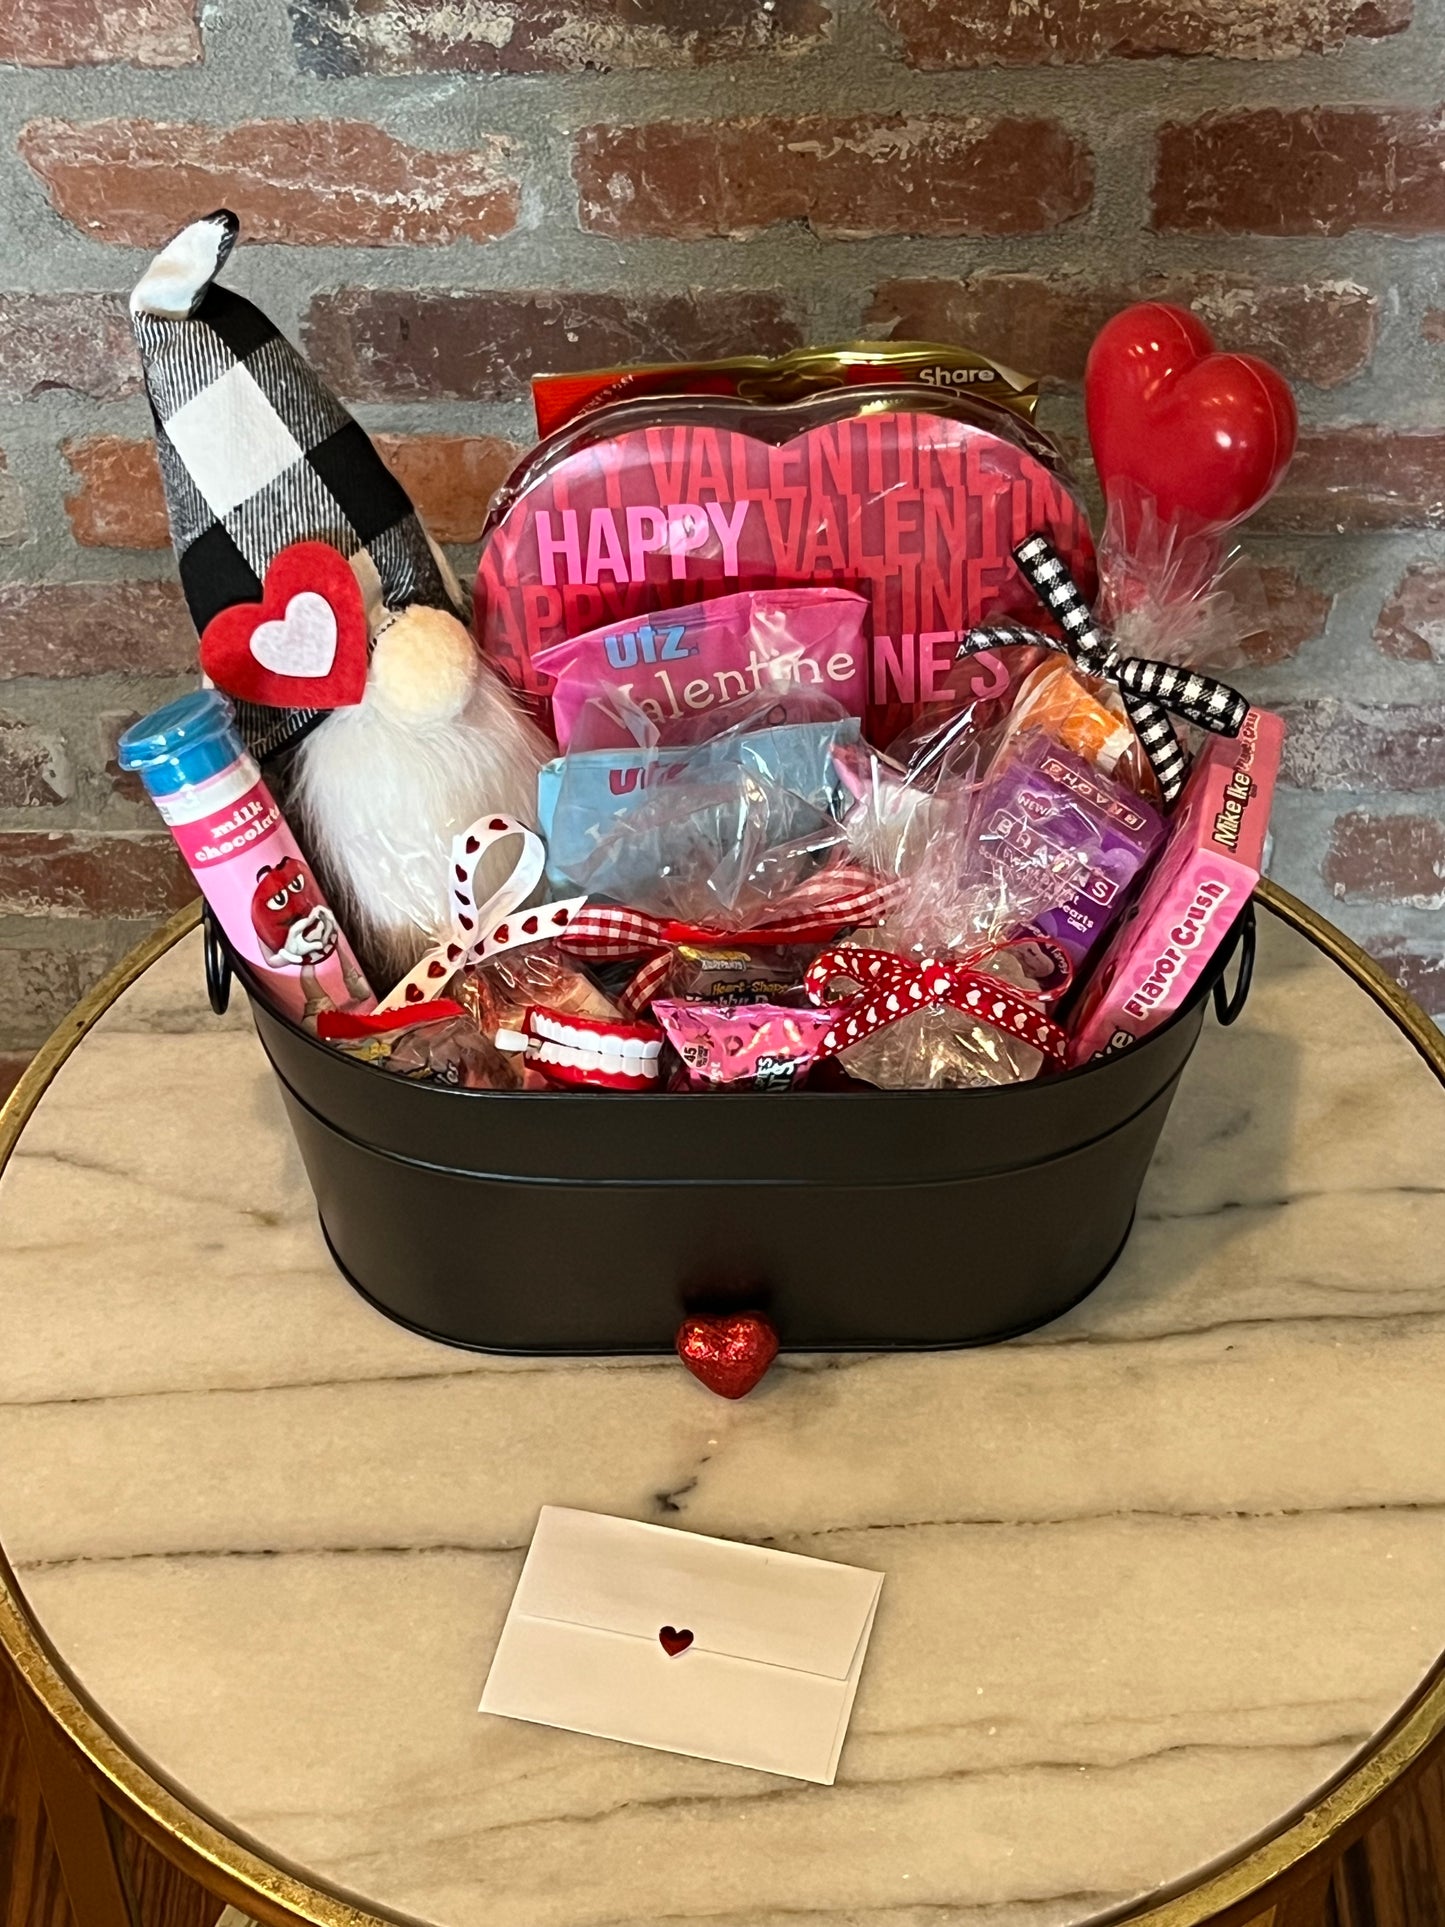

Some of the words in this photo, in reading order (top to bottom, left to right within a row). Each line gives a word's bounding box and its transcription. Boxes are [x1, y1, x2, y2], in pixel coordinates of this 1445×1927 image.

[919, 366, 996, 386] Share
[534, 500, 750, 587] HAPPY
[1226, 772, 1251, 801] Ike
[194, 804, 280, 863] chocolat
[210, 801, 264, 839] milk
[1213, 800, 1242, 847] Mike
[1126, 947, 1182, 1019] Flavor
[1170, 881, 1226, 950] Crush
